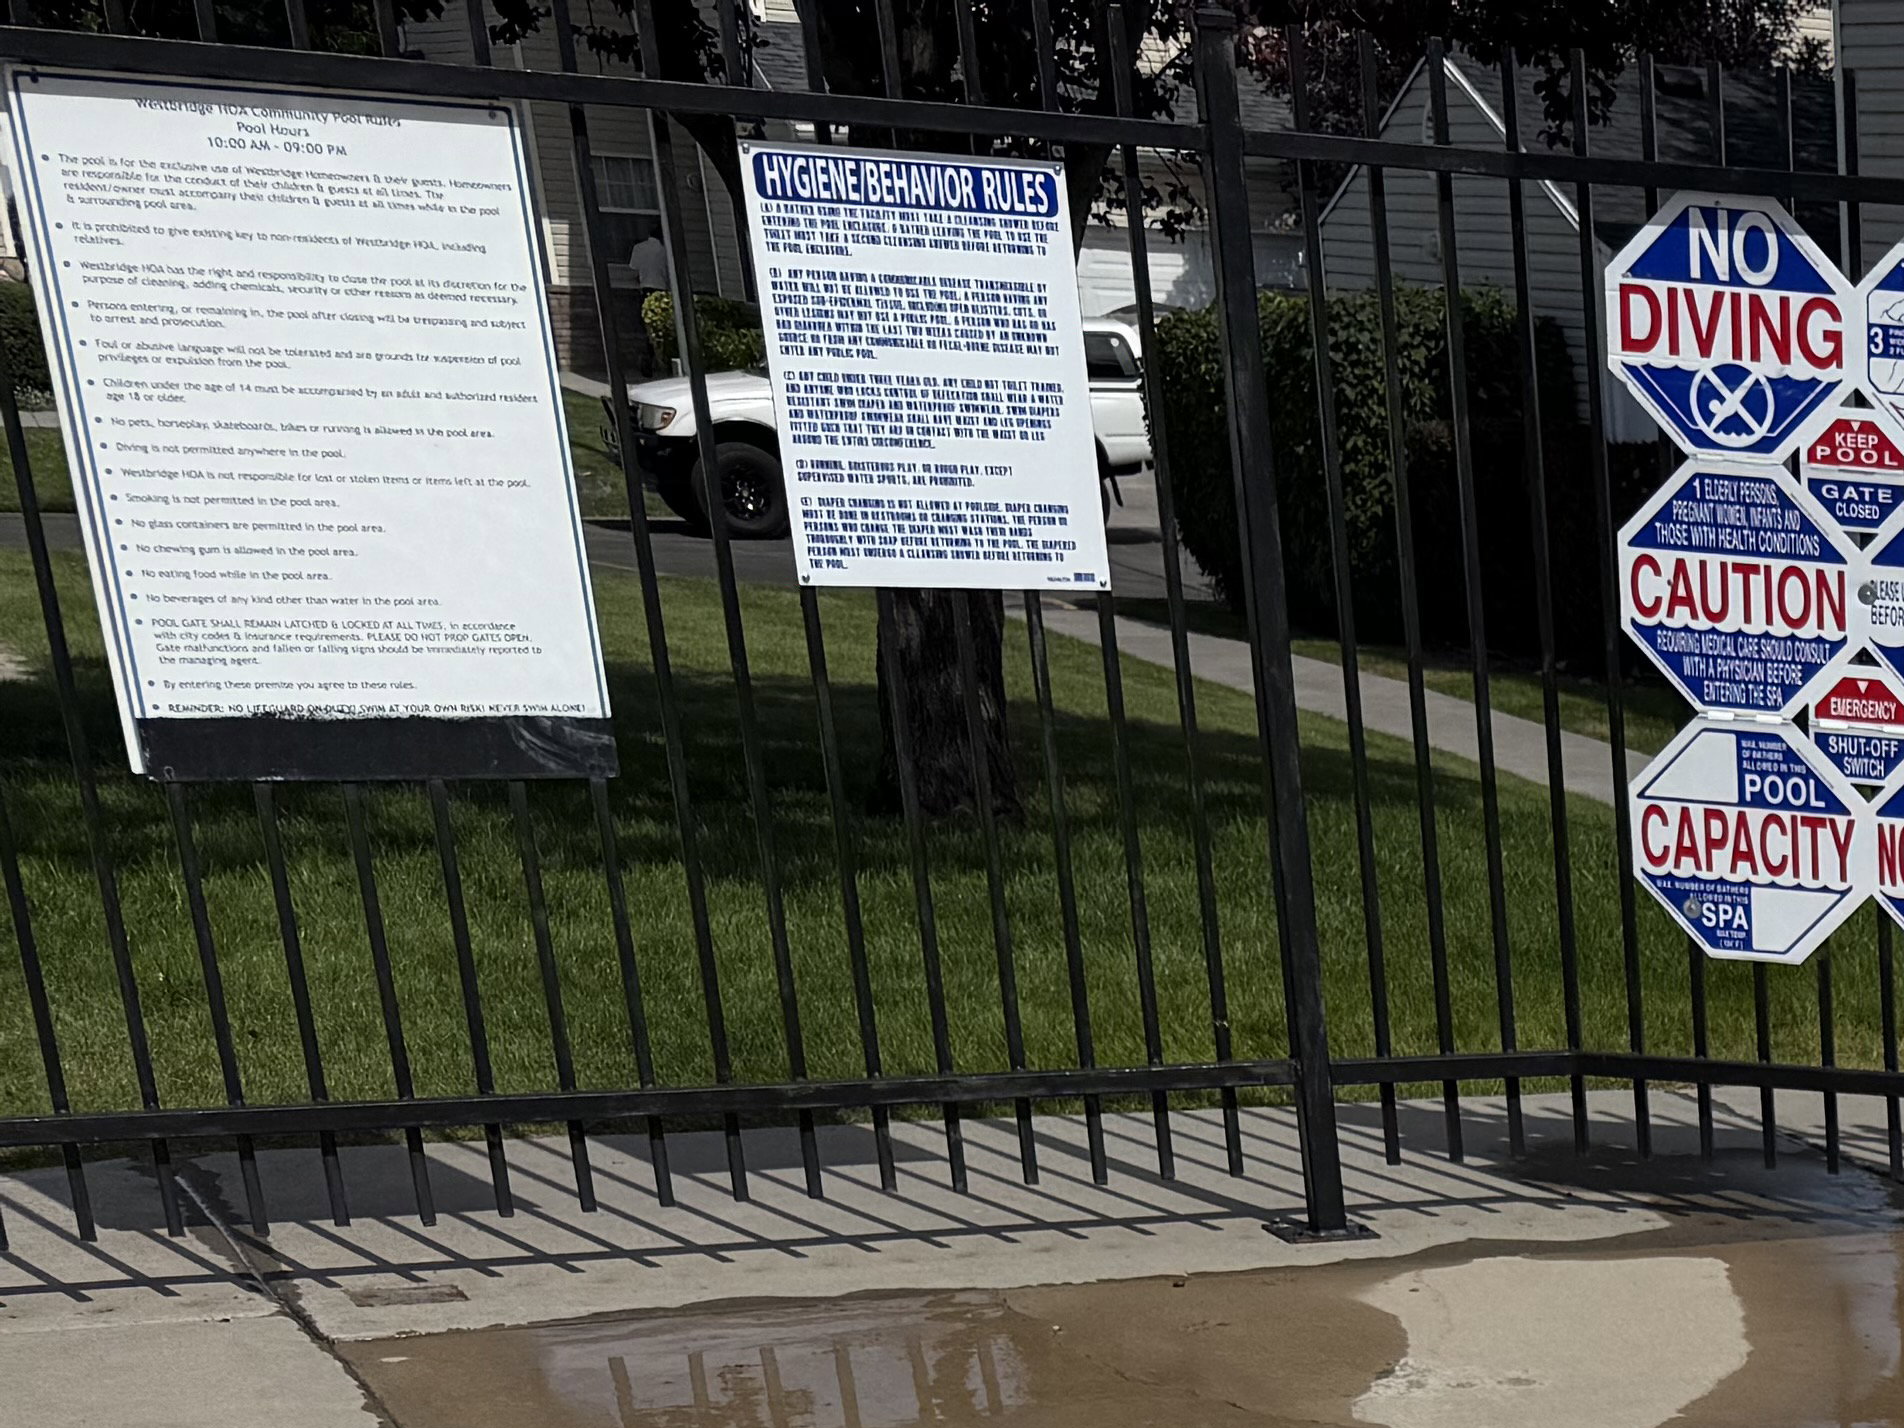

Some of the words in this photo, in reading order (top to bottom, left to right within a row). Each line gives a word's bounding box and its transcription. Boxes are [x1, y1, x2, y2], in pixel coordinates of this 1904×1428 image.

[237, 122, 266, 135] Pool
[271, 125, 309, 138] Hours
[208, 137, 245, 149] 10:00
[250, 139, 270, 151] AM
[284, 142, 323, 154] 09:00
[328, 144, 347, 156] PM
[762, 154, 977, 209] HYGIENE/BEHAVIOR
[982, 170, 1048, 214] RULES
[1689, 206, 1778, 286] NO
[1619, 283, 1843, 370] DIVING
[1870, 328, 1883, 354] 3
[1836, 432, 1878, 448] KEEP
[1816, 446, 1898, 466] POOL
[1705, 478, 1738, 501] ELDERLY
[1740, 482, 1779, 505] PERSONS,
[1822, 484, 1892, 503] GATE
[1673, 500, 1714, 522] PREGNANT
[1716, 503, 1748, 527] WOMEN,
[1751, 508, 1782, 530] INFANTS
[1784, 510, 1800, 530] AND
[1836, 502, 1879, 519] CLOSED
[1655, 522, 1688, 546] THOSE
[1691, 525, 1716, 548] WITH
[1719, 528, 1755, 551] HEALTH
[1759, 530, 1820, 556] CONDITIONS
[1631, 553, 1846, 632] CAUTION
[1657, 630, 1700, 652] REQUIRING
[1702, 635, 1735, 656] MEDICAL
[1738, 638, 1758, 658] CARE
[1761, 640, 1792, 660] SHOULD
[1794, 642, 1830, 664] CONSULT
[1683, 656, 1708, 676] WITH
[1709, 659, 1715, 676] A
[1717, 660, 1764, 681] PHYSICIAN
[1767, 664, 1802, 686] BEFORE
[1704, 681, 1746, 702] ENTERING
[1748, 684, 1764, 704] THE
[1766, 687, 1782, 707] SPA
[1831, 697, 1896, 721] EMERGENCY
[1829, 735, 1898, 758] SHUT-OFF
[1844, 757, 1884, 778] SWITCH
[1745, 774, 1825, 808] POOL
[1641, 804, 1855, 883] CAPACITY
[1702, 903, 1748, 930] SPA
